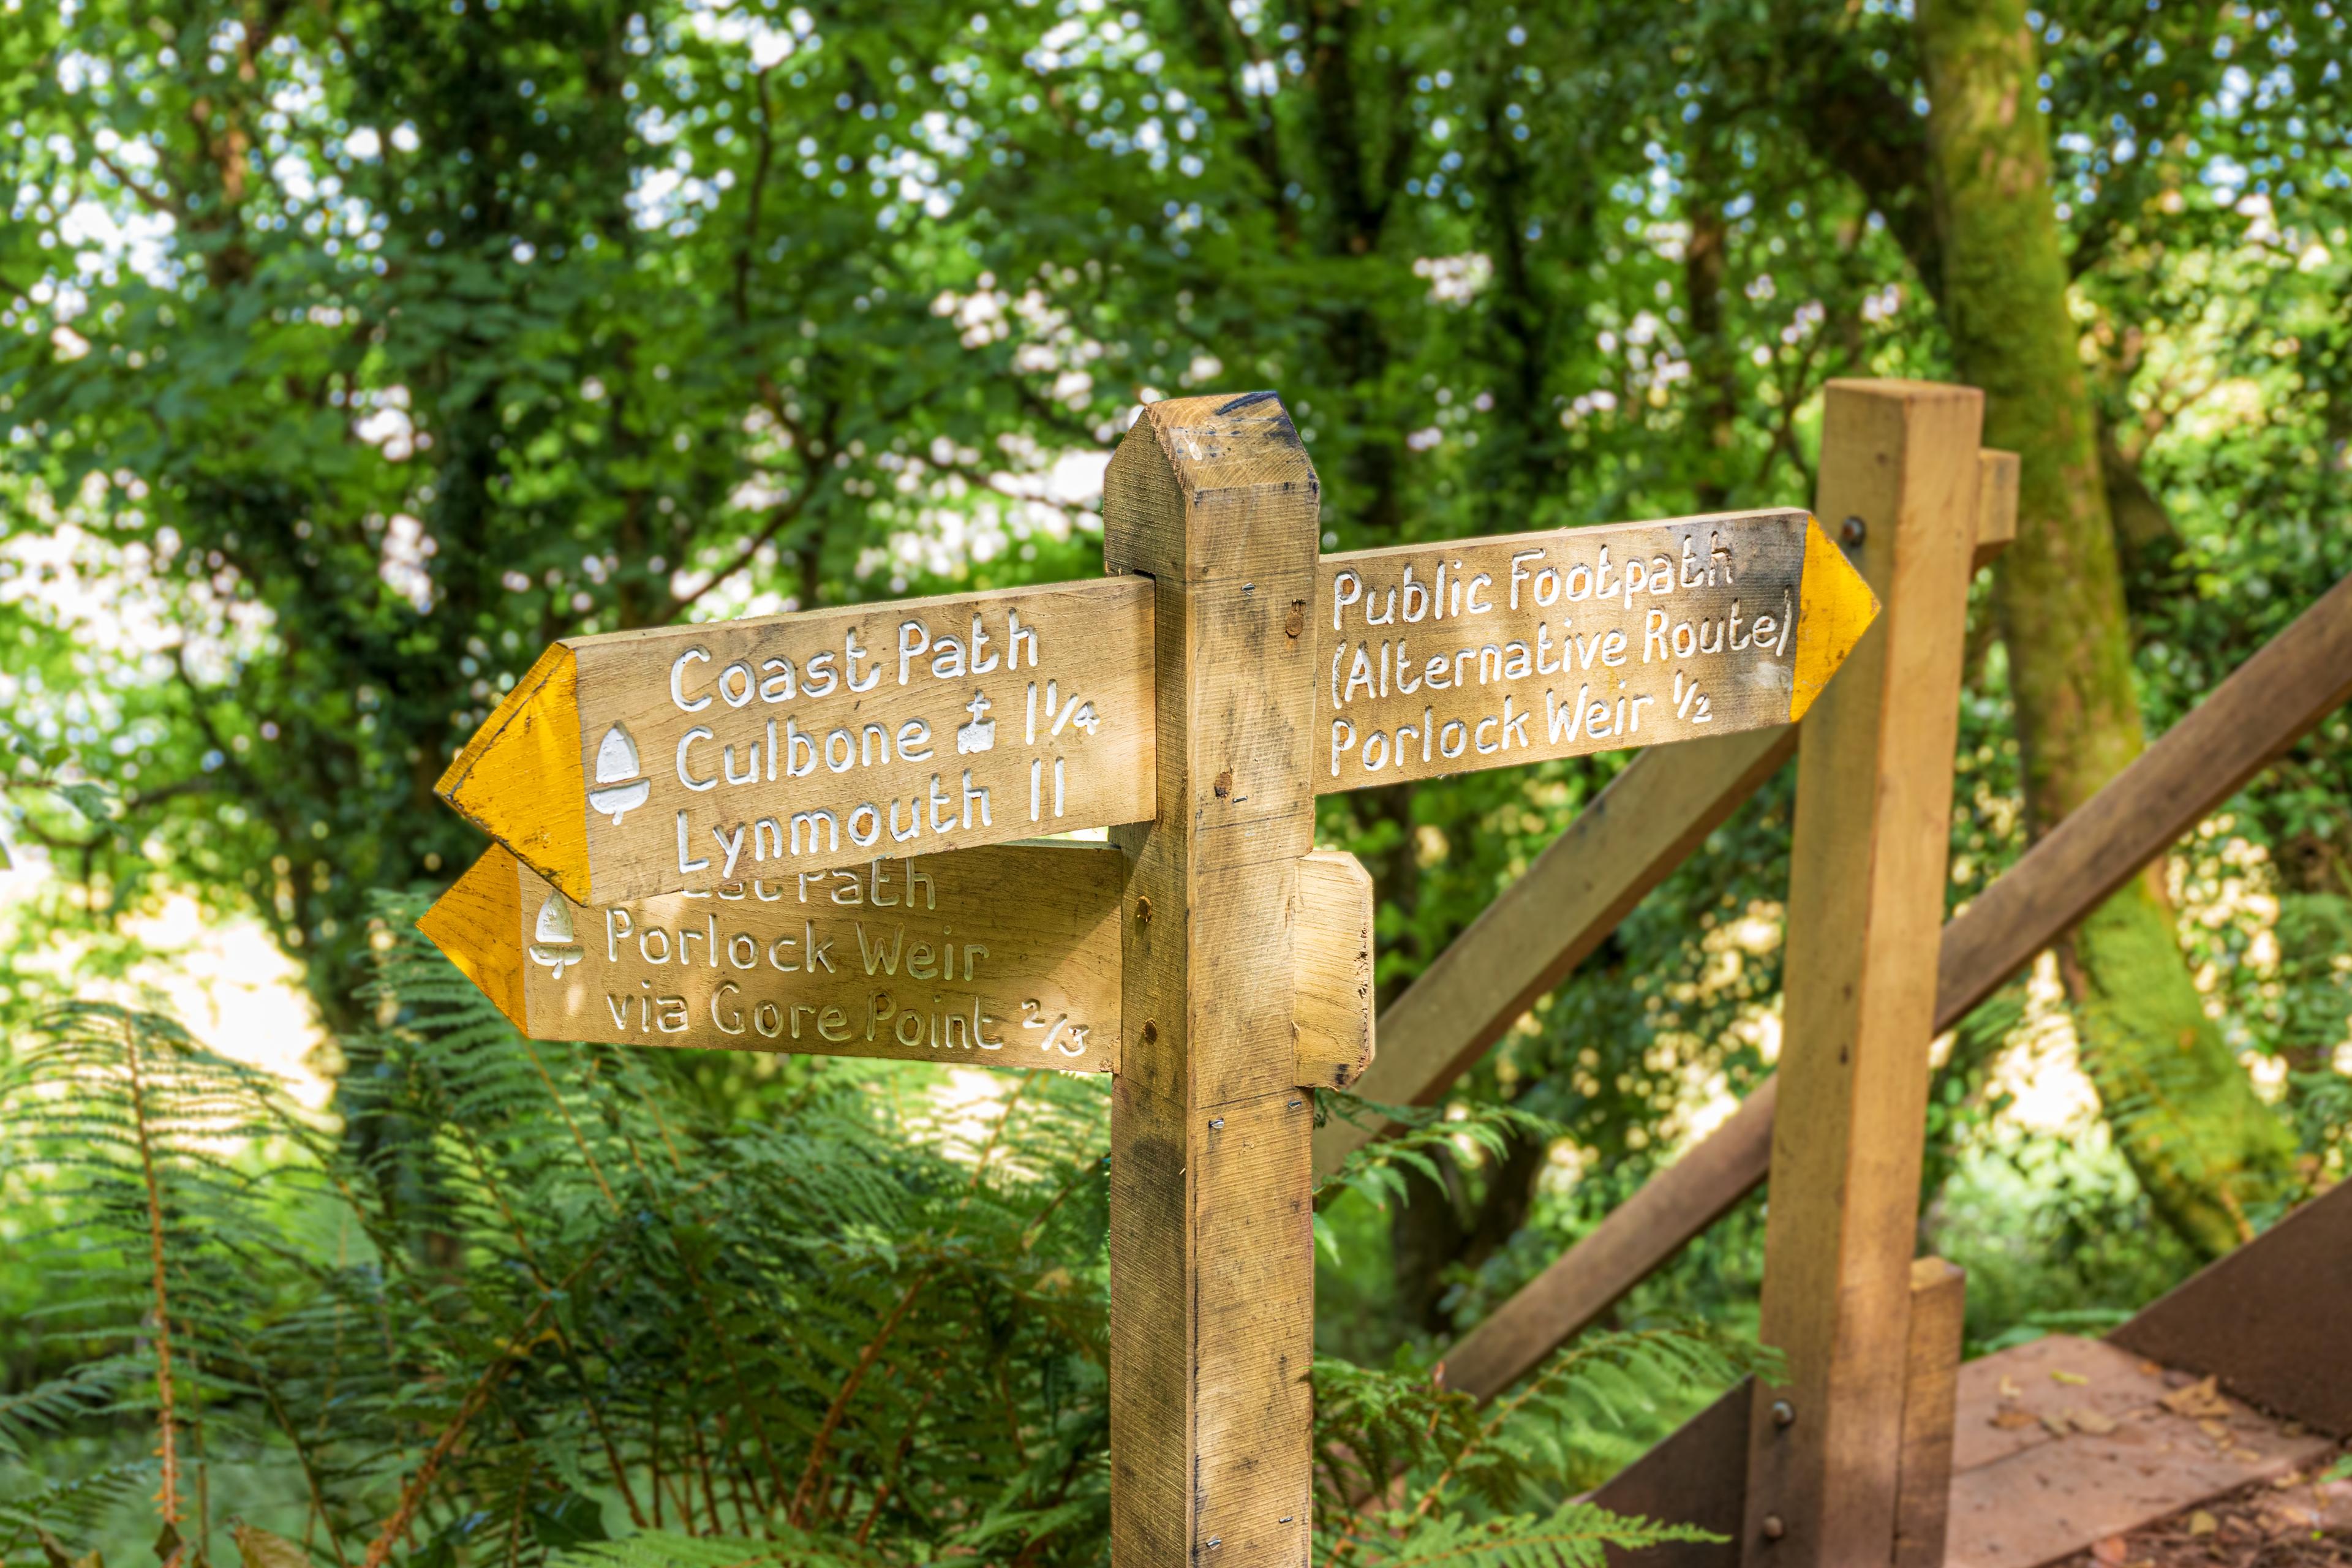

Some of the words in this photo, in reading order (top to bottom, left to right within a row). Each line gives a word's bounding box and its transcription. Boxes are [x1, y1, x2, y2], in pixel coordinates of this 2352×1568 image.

[1333, 559, 1492, 631] Public
[1510, 531, 1734, 609] Footpath
[670, 625, 881, 713] Coast
[898, 608, 1038, 685] Path
[1332, 617, 1627, 710] (Alternative
[1643, 585, 1792, 664] Route)
[676, 715, 934, 792] Culbone
[1331, 695, 1530, 777] Porlock
[1545, 679, 1654, 745] Weir
[677, 768, 992, 878] Lynmouth
[606, 907, 835, 974] Porlock
[857, 922, 989, 981] Weir
[606, 981, 689, 1033] via
[710, 980, 851, 1041] Gore
[867, 988, 1003, 1050] Point
